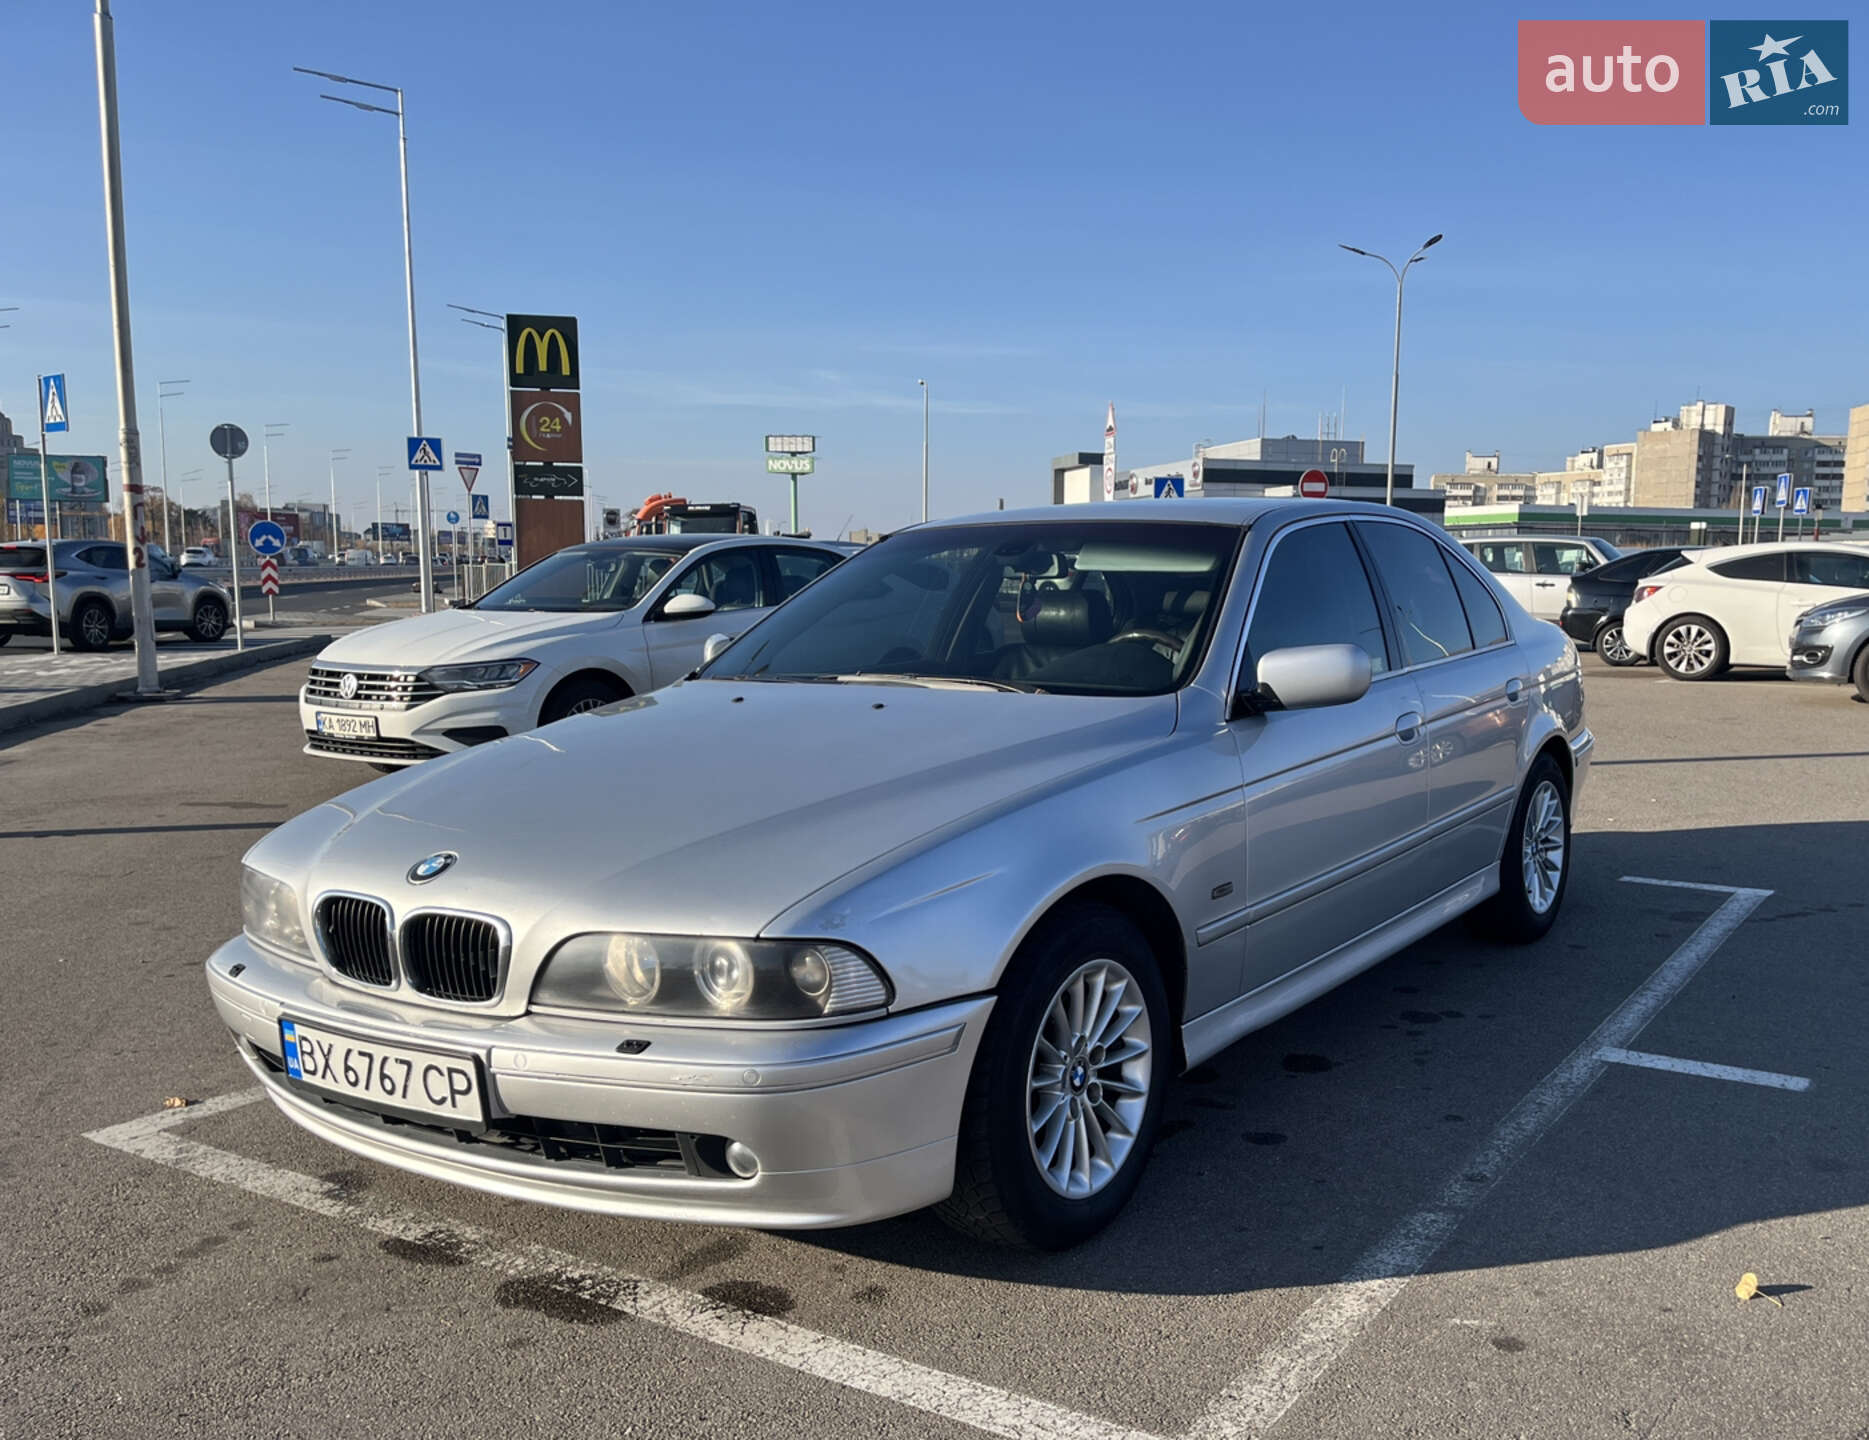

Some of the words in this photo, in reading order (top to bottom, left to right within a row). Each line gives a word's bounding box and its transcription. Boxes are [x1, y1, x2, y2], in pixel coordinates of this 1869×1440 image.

[539, 416, 562, 432] 24
[768, 459, 810, 471] NOVUS
[322, 715, 335, 731] KA
[336, 717, 358, 733] 1892
[287, 1057, 299, 1069] UA
[299, 1034, 338, 1083] BX
[343, 1047, 413, 1099] 6767
[422, 1063, 473, 1109] CP
